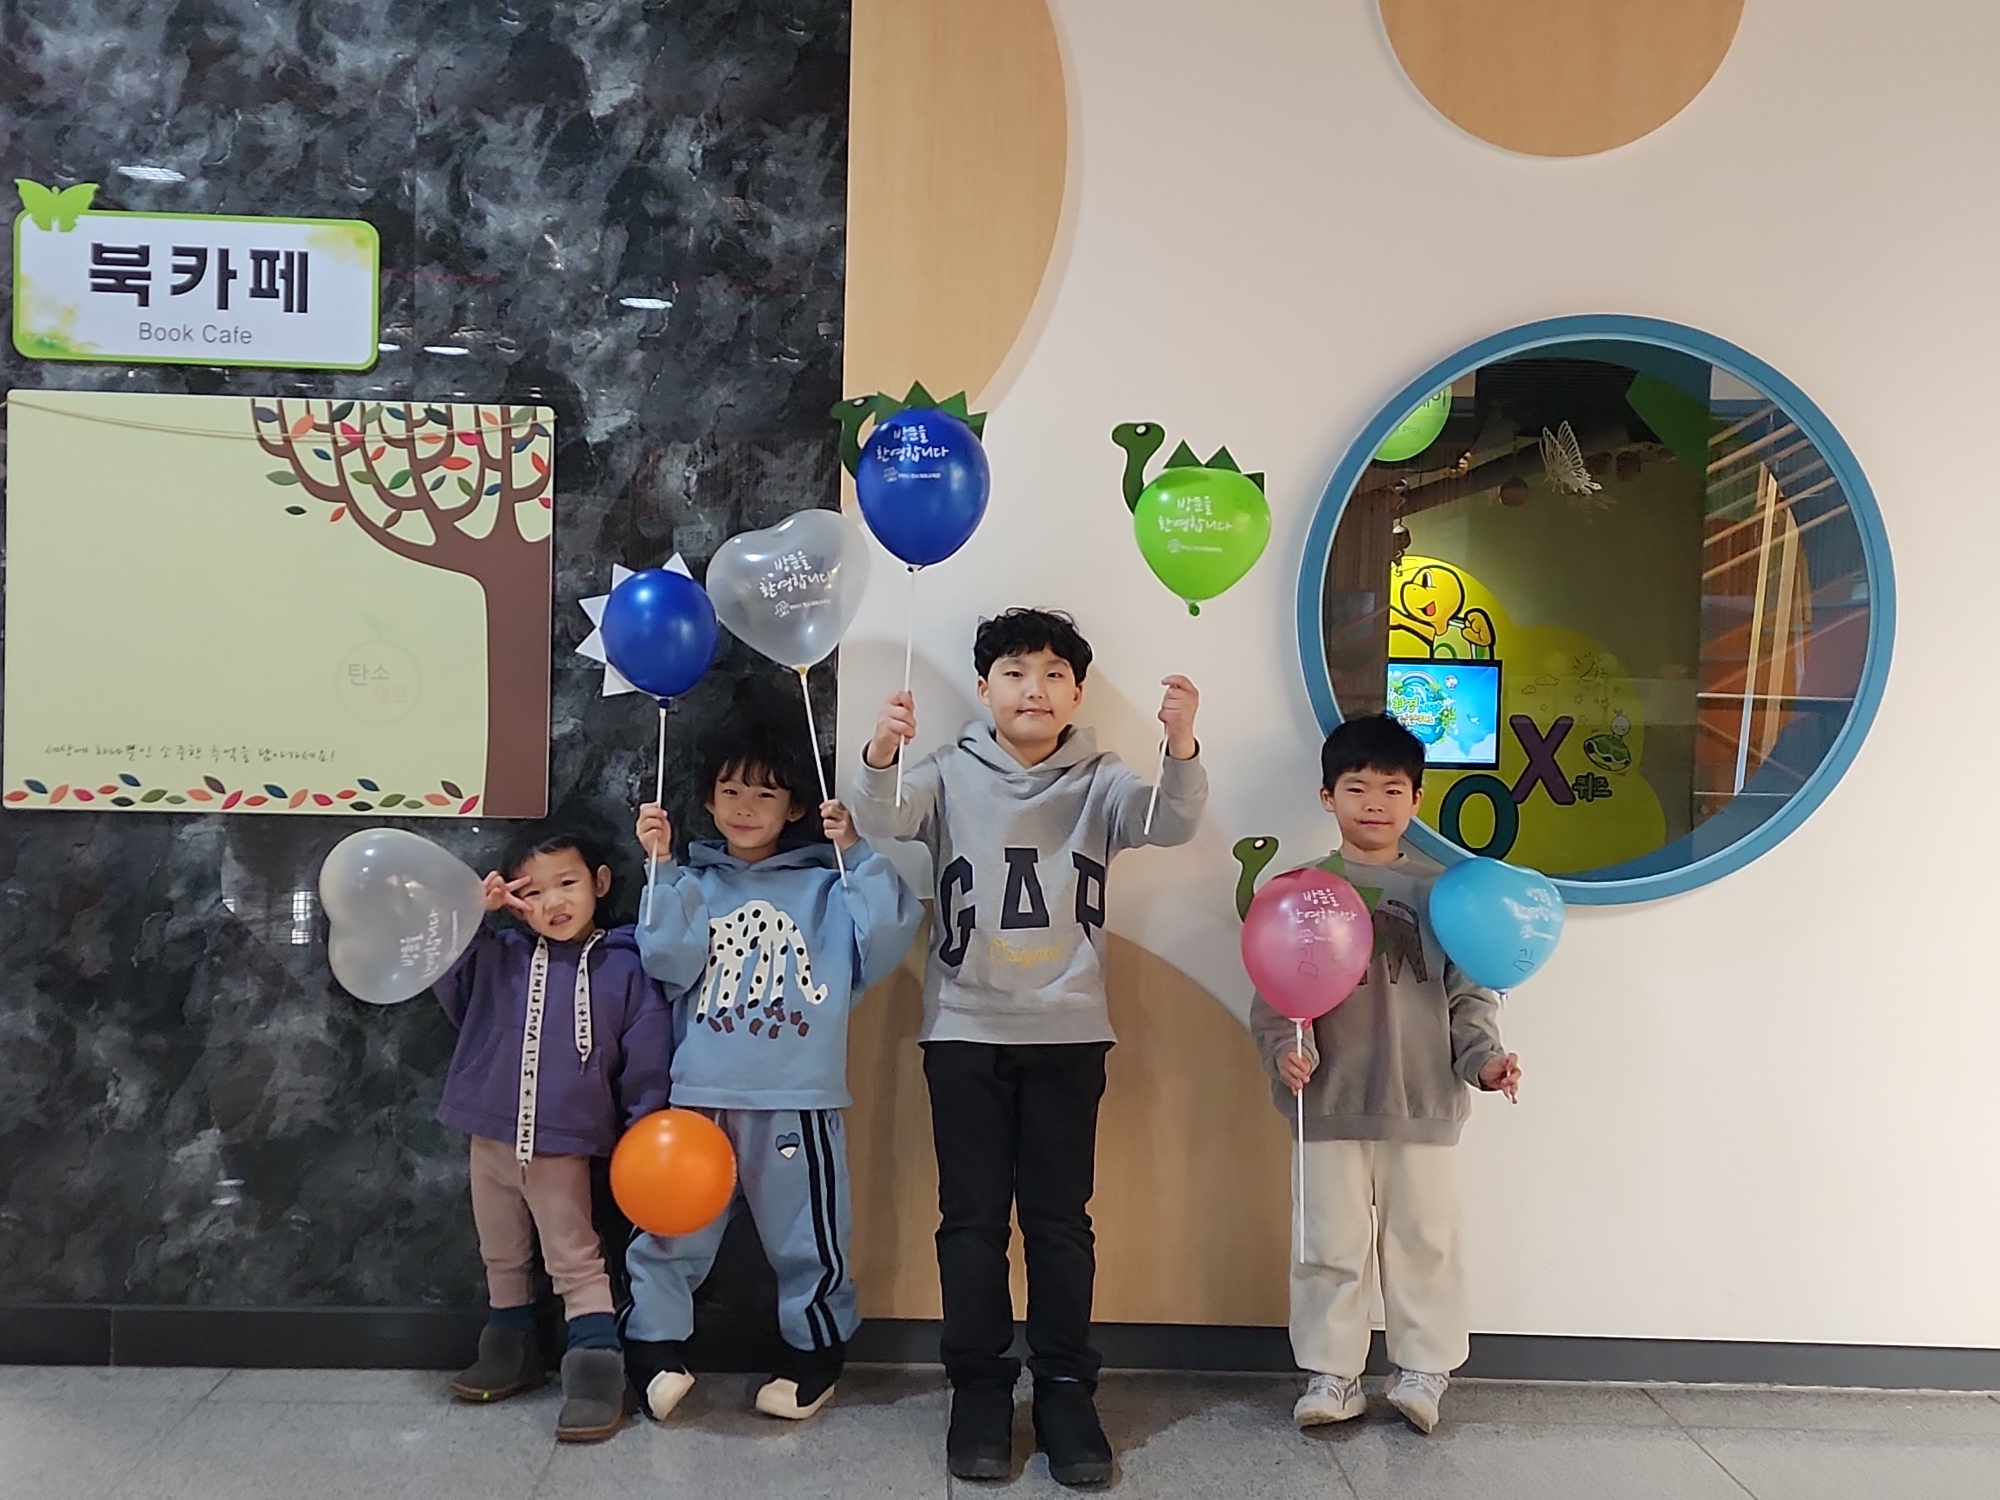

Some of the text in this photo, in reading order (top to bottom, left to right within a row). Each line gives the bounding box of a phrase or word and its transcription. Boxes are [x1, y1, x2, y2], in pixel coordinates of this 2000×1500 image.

[89, 242, 309, 314] 북카페
[138, 321, 253, 345] Book Cafe
[893, 424, 930, 444] 방문을
[876, 443, 950, 463] 환영합니다
[1176, 495, 1213, 515] 방문을
[1158, 515, 1234, 533] 환영합니다
[773, 550, 812, 572] 방문을
[347, 662, 390, 686] 탄소
[160, 744, 202, 761] 소중한
[210, 744, 250, 764] 추억을
[1302, 888, 1340, 907] 방문을
